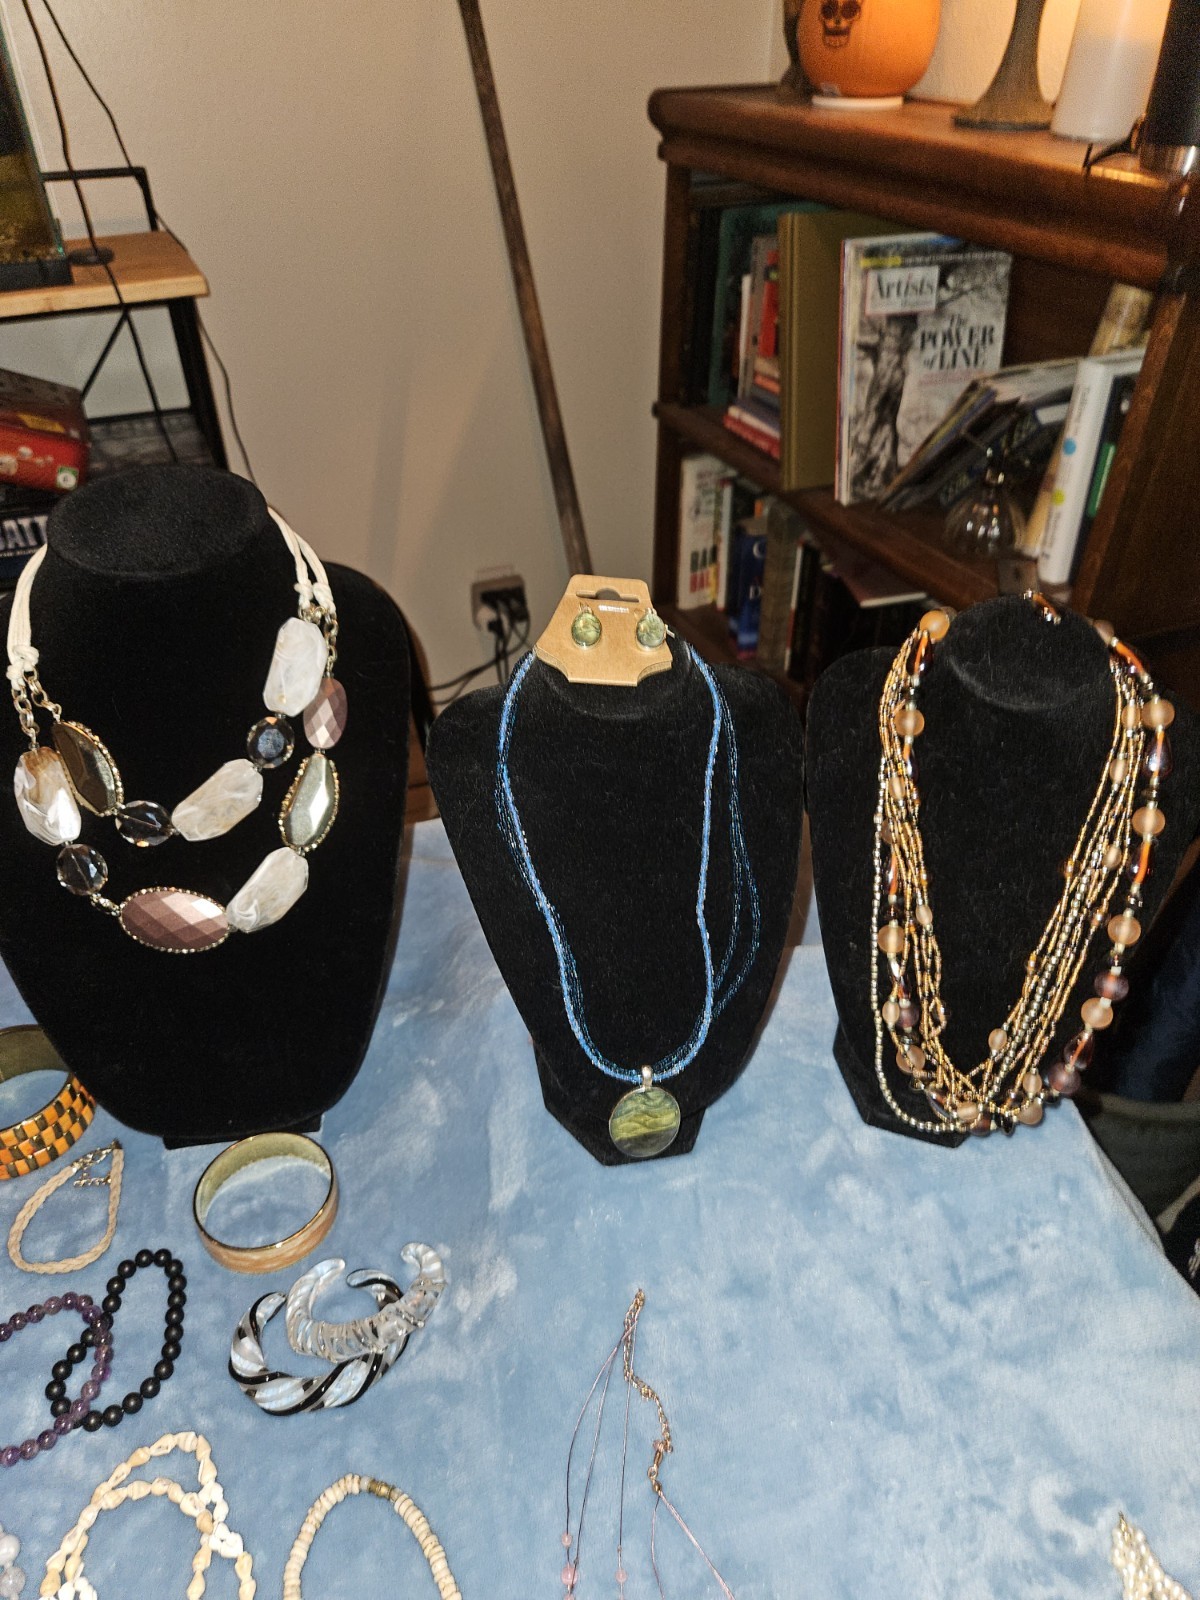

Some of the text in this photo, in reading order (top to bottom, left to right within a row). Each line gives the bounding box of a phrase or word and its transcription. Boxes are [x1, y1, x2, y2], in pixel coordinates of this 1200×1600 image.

[919, 325, 995, 352] POWER
[938, 347, 987, 371] LINE
[0, 515, 48, 550] ATT
